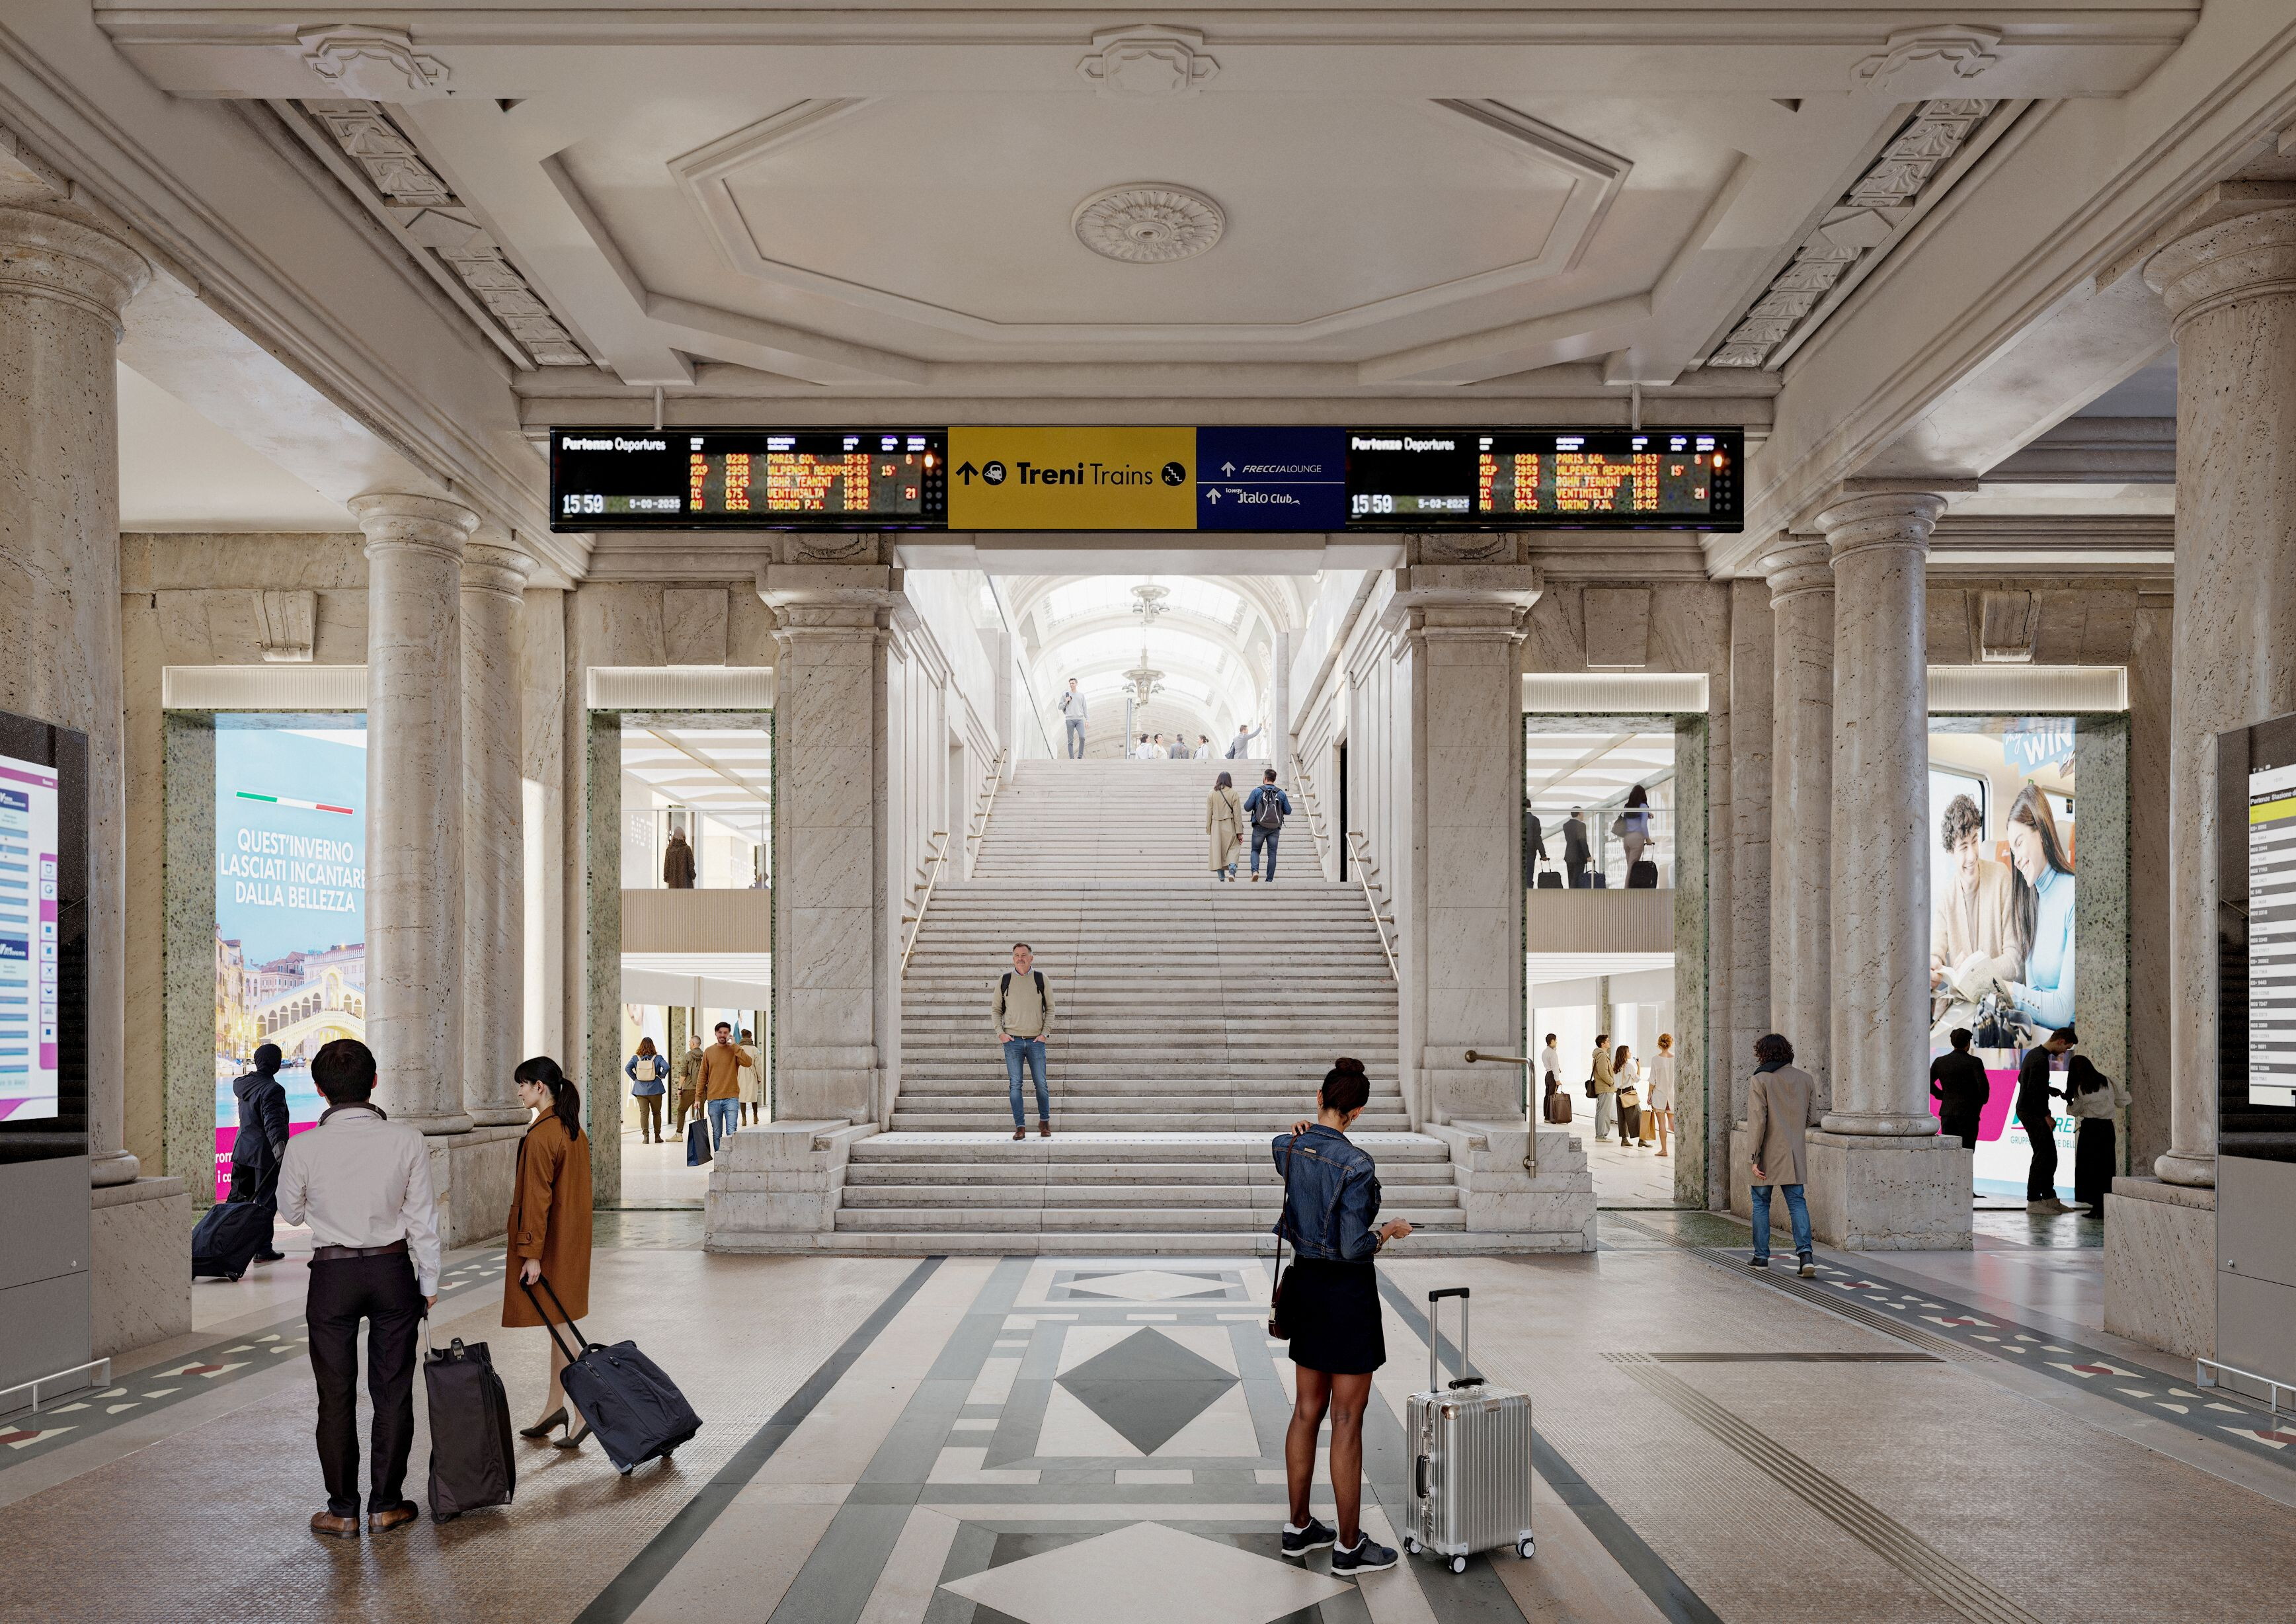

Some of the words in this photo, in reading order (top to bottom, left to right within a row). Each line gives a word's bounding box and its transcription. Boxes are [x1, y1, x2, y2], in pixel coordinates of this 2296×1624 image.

[1017, 462, 1084, 485] Treni
[1089, 464, 1153, 485] Trains
[725, 488, 743, 499] 675
[906, 488, 916, 499] 21
[1514, 488, 1532, 499] 675
[1694, 488, 1704, 499] 21
[237, 828, 354, 864] QUEST'INVERNO
[221, 853, 286, 881] LASCIATI
[235, 881, 284, 907] DALLA
[289, 886, 356, 913] BELLEZZA
